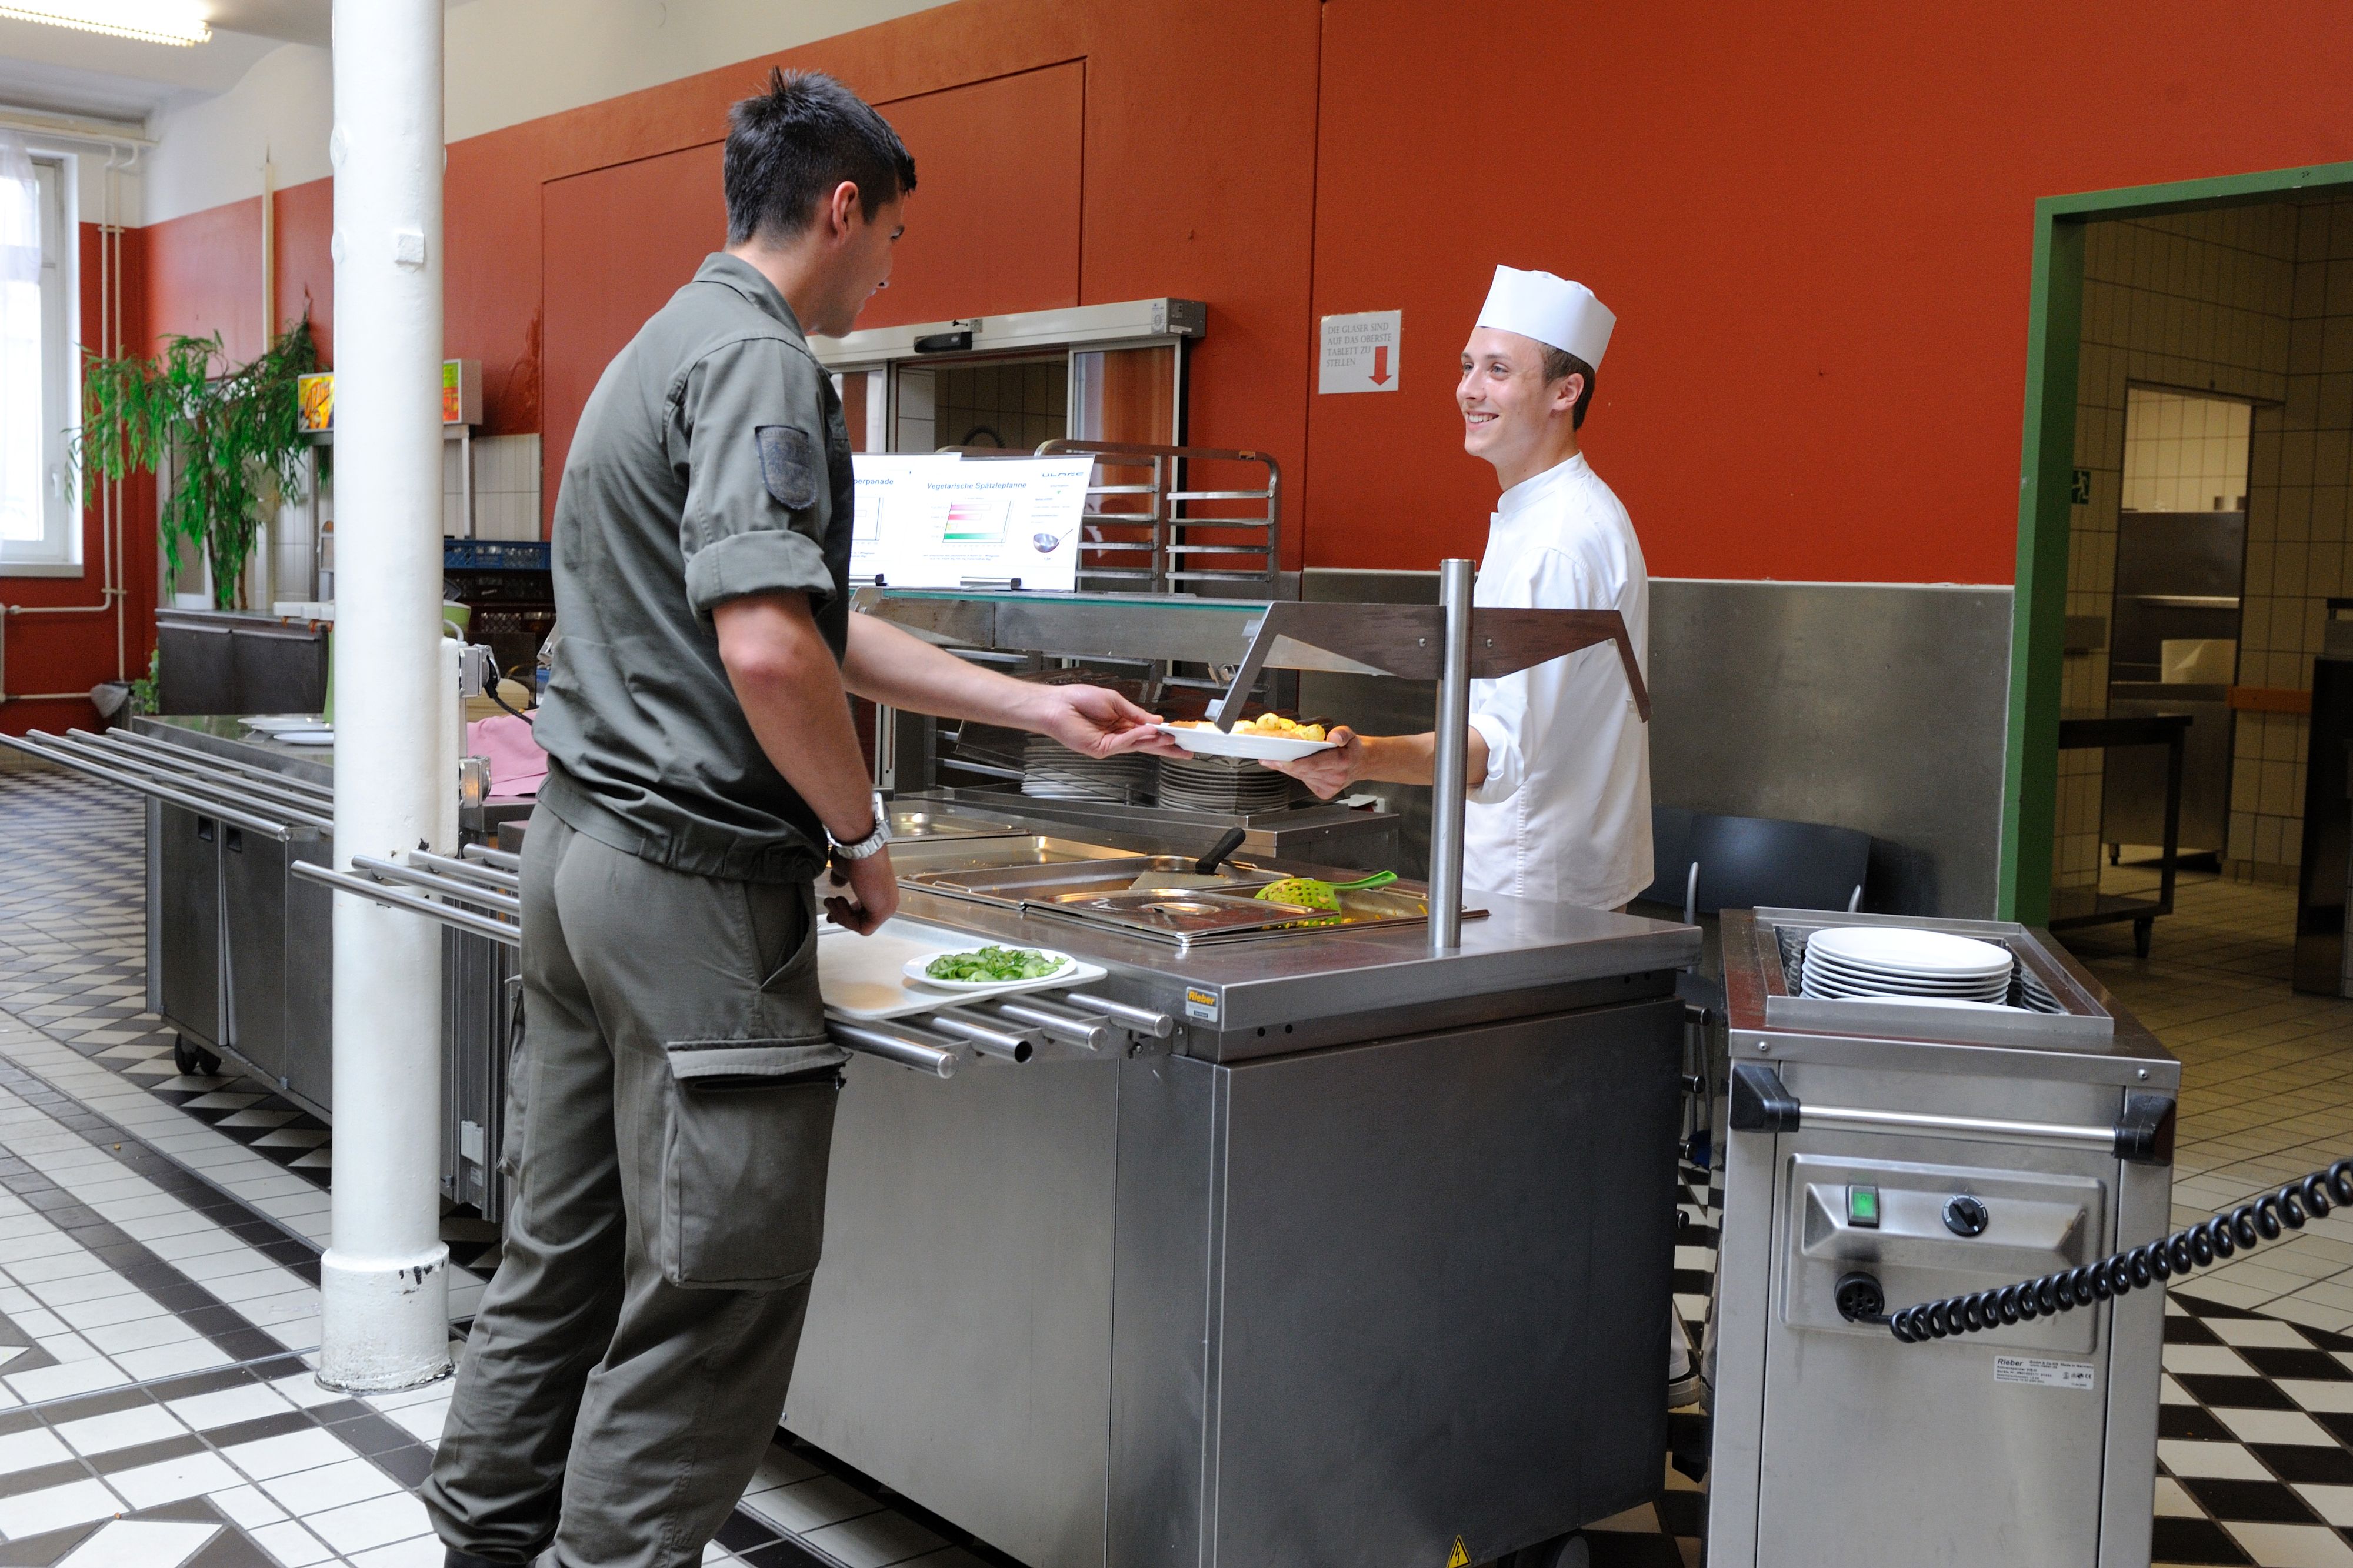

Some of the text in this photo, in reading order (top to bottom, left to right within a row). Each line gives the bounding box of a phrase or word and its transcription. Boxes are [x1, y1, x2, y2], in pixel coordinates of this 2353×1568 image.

[1328, 326, 1339, 335] DIE
[1371, 323, 1389, 332] SIND
[1327, 333, 1392, 345] AUF DAS OBERSTE
[1327, 346, 1371, 356] TABLETT ZU
[1327, 358, 1356, 367] STELLEN
[927, 482, 974, 491] Vegetarische
[1188, 990, 1215, 1006] Rieber
[1997, 1358, 2024, 1366] Rieber
